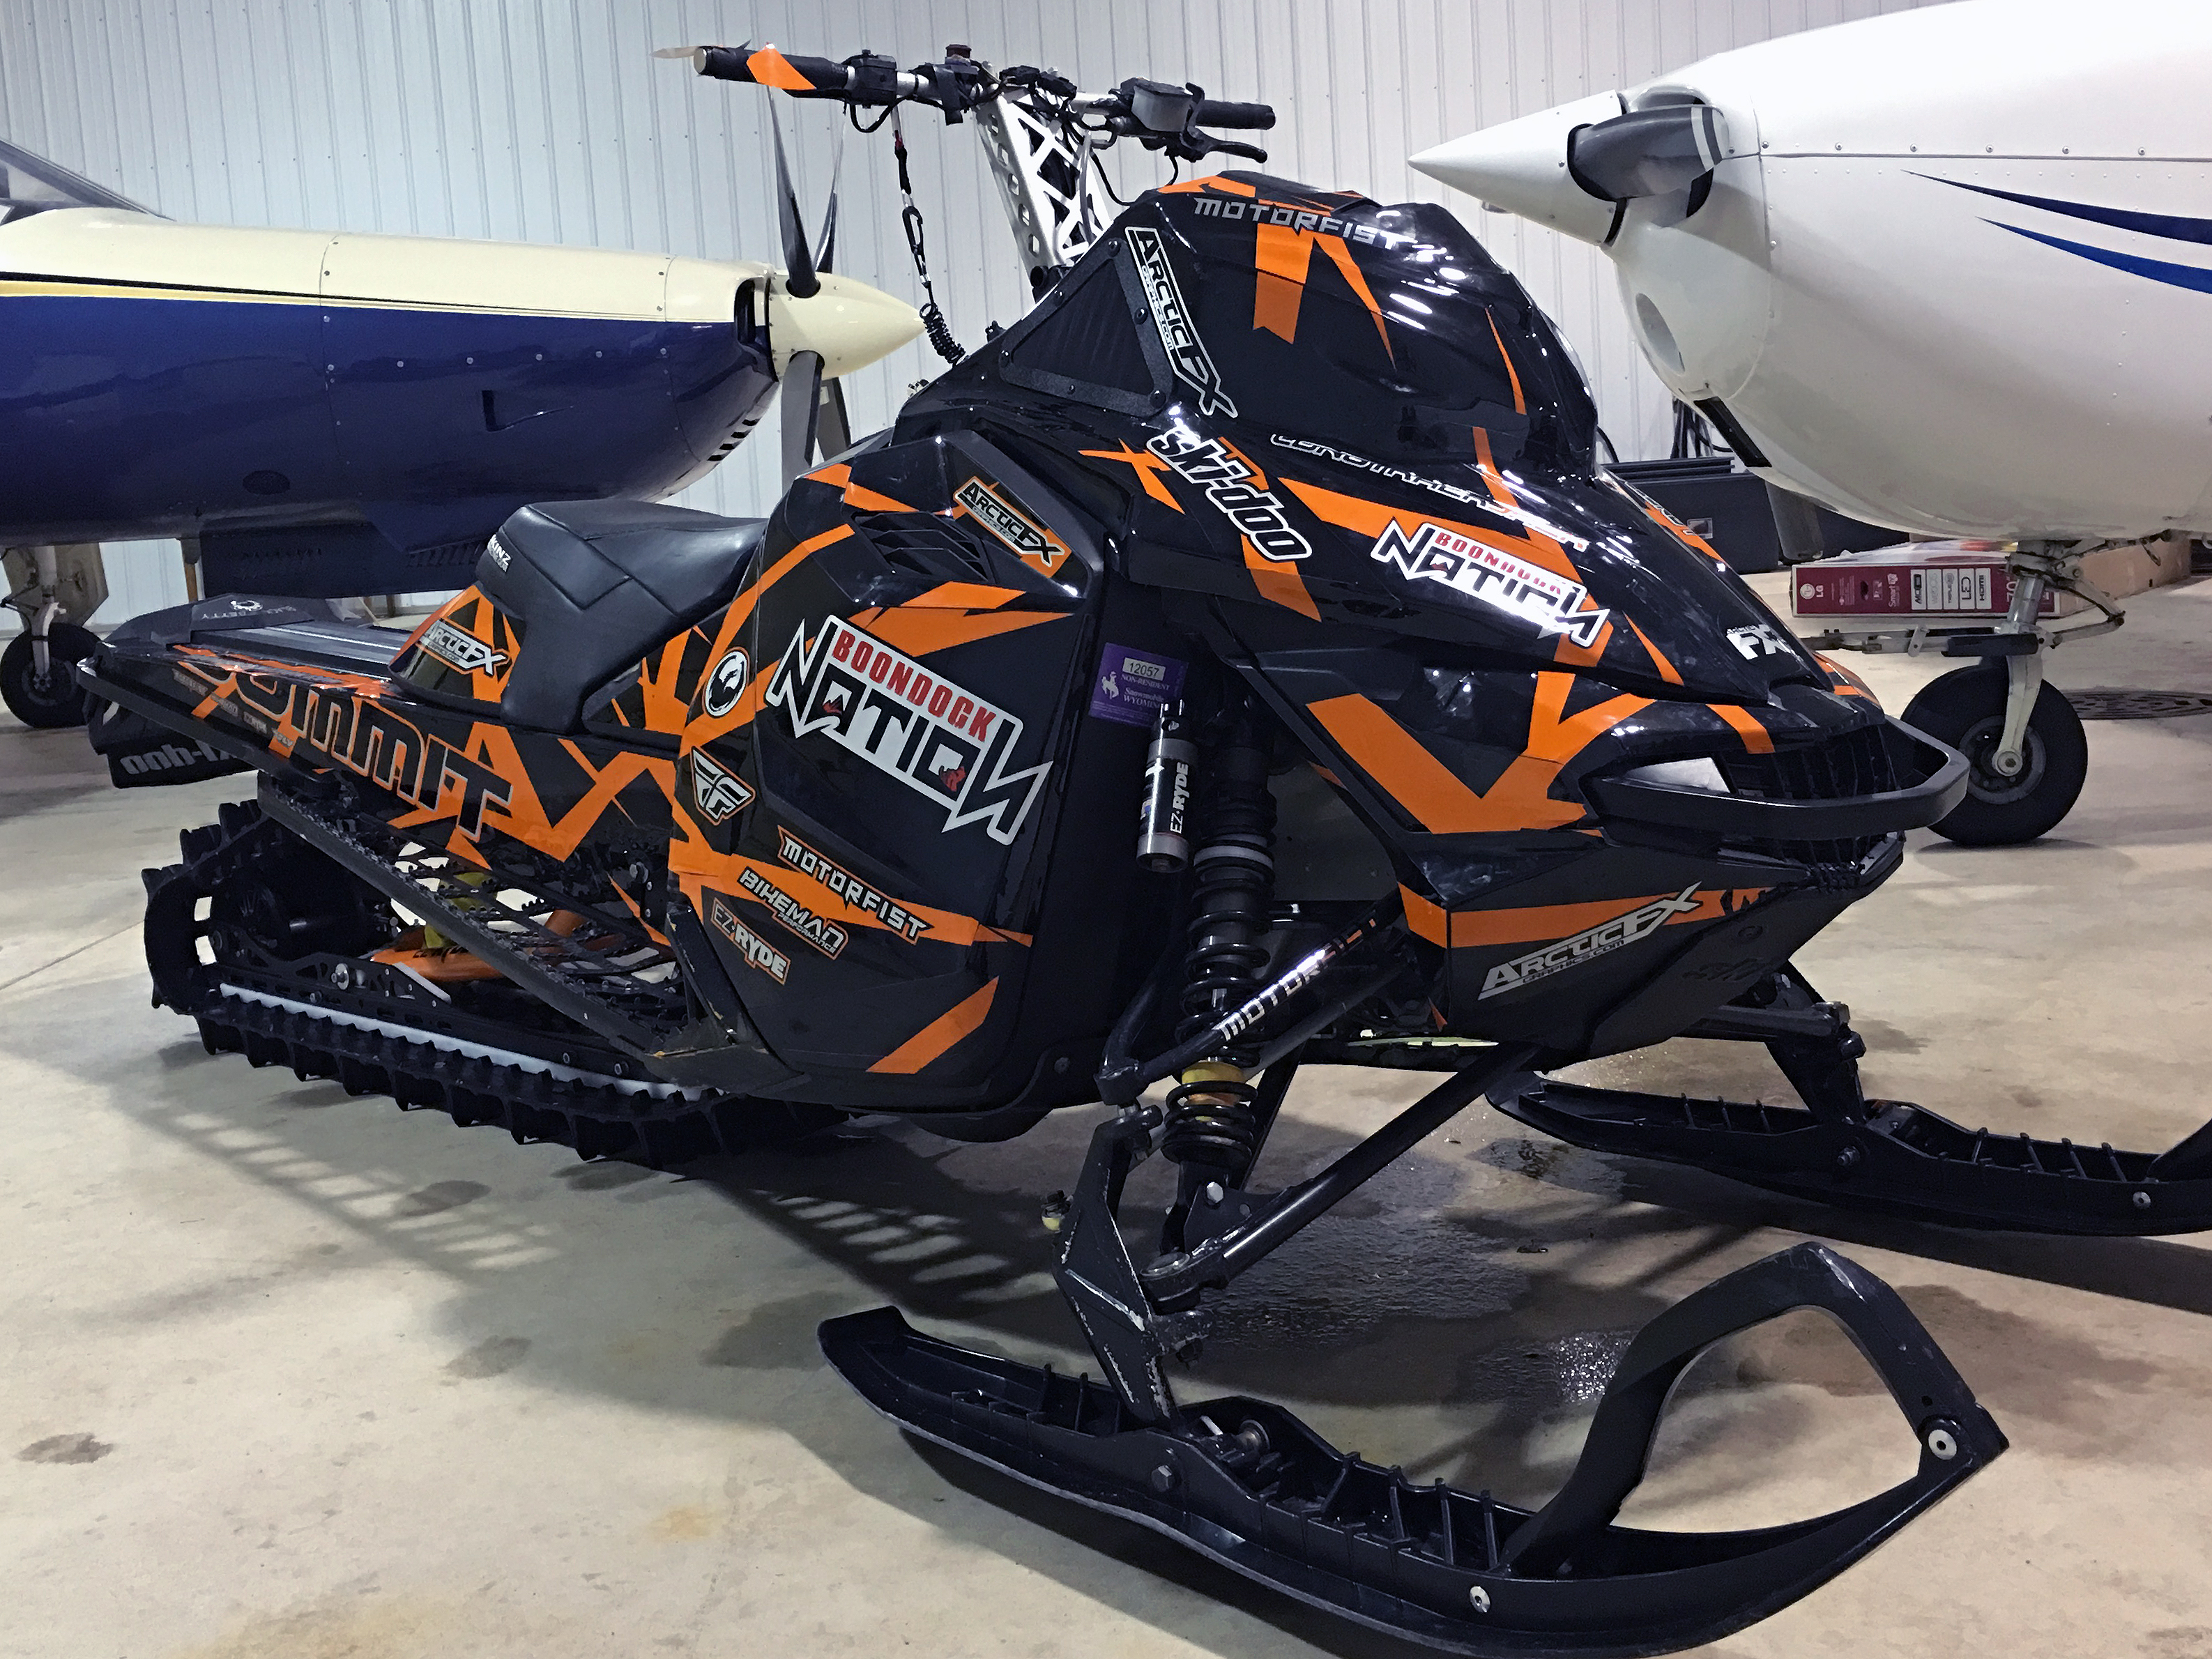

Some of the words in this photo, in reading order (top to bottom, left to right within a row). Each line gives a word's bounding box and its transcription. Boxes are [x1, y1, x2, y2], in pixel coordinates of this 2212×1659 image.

[1193, 197, 1418, 250] MOTORFIST
[487, 534, 511, 566] KINZ
[1815, 585, 1824, 598] LG
[1961, 576, 1971, 600] LED
[831, 627, 997, 743] BOONDOCK
[1129, 663, 1160, 678] 12057
[1124, 694, 1161, 709] WYOMIN
[766, 615, 1053, 846] NATION
[782, 836, 929, 938] MOTORFIST
[739, 869, 844, 948] BIKEMAN
[777, 912, 837, 954] PERFORMANCE
